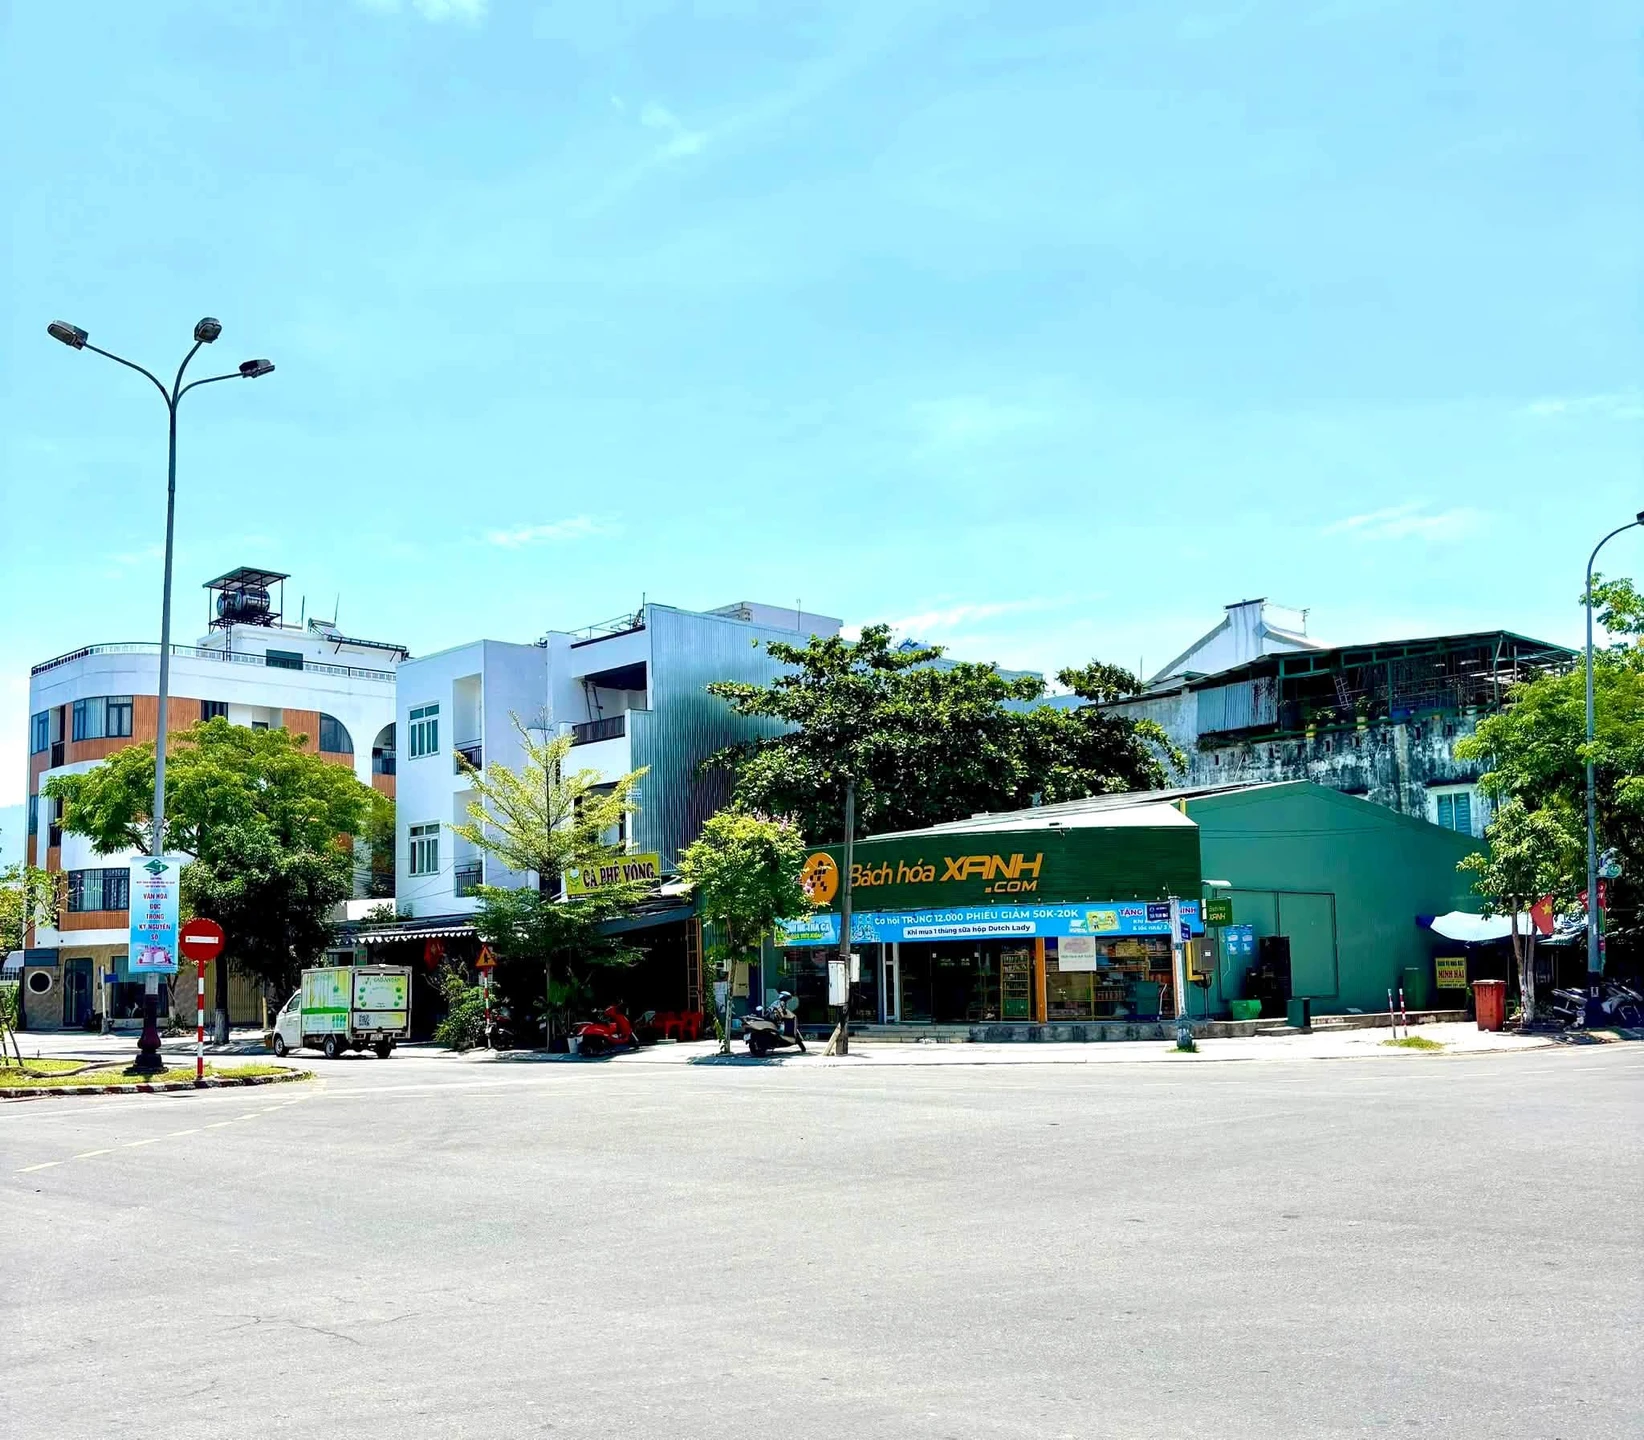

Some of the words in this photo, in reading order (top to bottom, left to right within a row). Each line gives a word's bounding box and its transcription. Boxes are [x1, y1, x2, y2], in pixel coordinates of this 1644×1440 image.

[599, 860, 621, 884] PHÊ
[850, 860, 893, 887] Bách
[896, 858, 936, 884] hóa
[940, 853, 1044, 882] XANH
[985, 880, 1038, 893] .COM
[887, 916, 900, 925] hội
[934, 912, 963, 922] 12.000
[1001, 907, 1030, 919] GIẢM
[1033, 909, 1079, 918] 50K-20K
[907, 928, 917, 936] Khi
[938, 927, 957, 936] thùng
[972, 925, 987, 934] hộp
[1011, 924, 1031, 932] Lady
